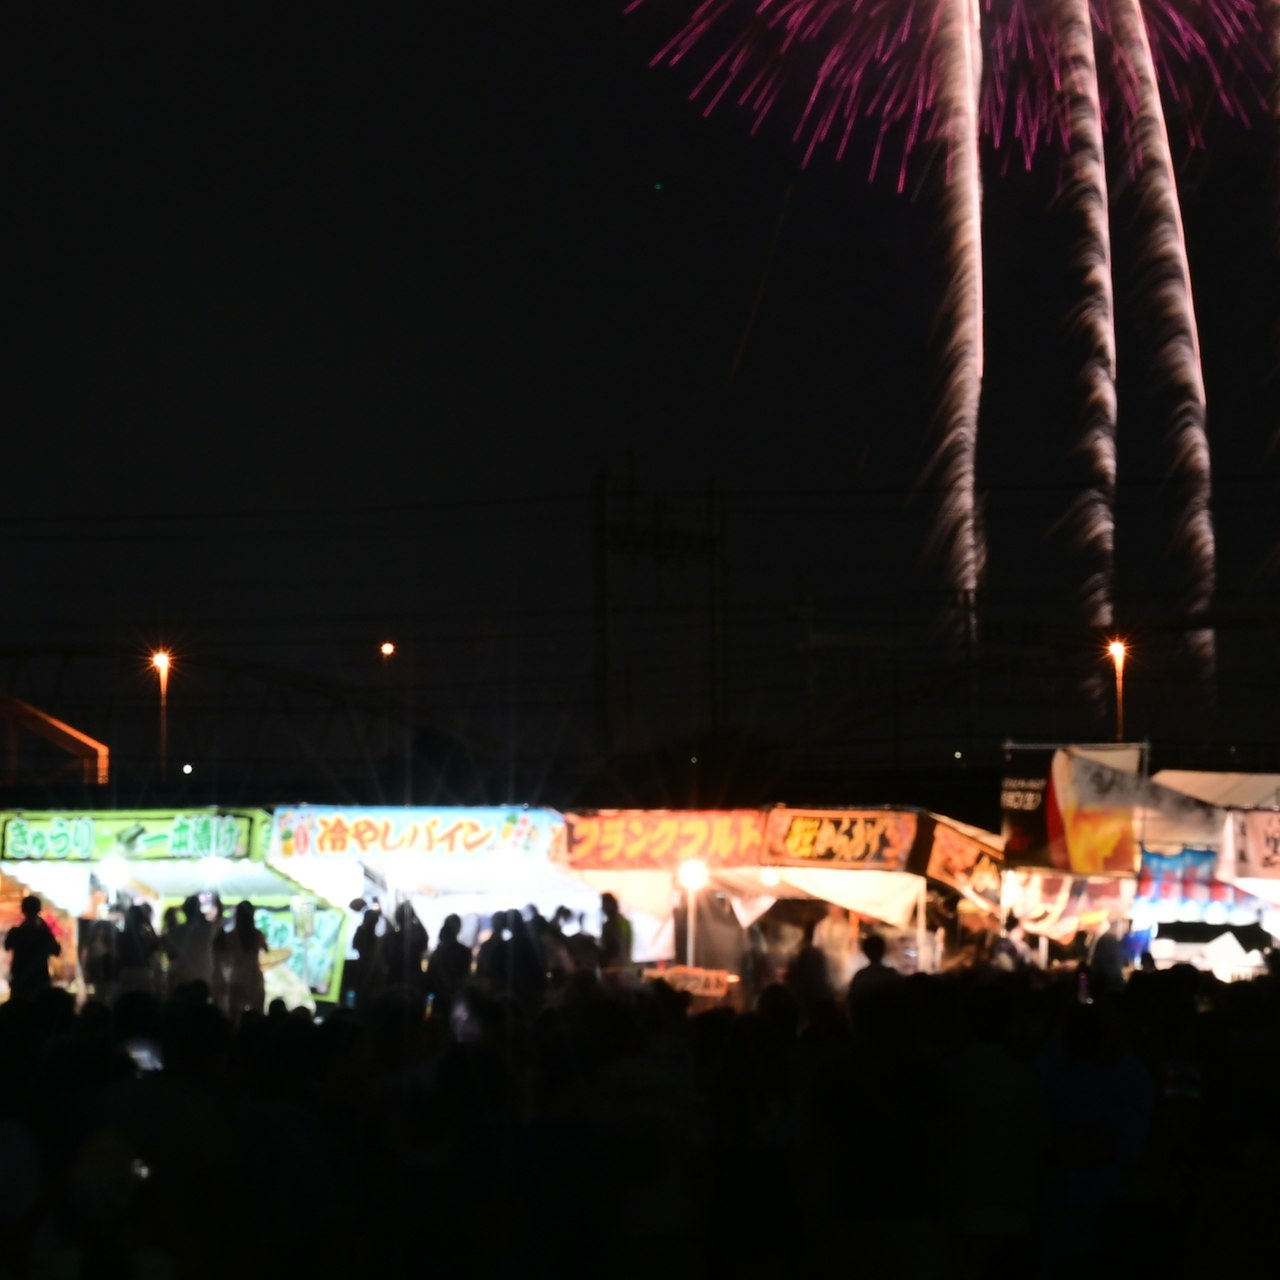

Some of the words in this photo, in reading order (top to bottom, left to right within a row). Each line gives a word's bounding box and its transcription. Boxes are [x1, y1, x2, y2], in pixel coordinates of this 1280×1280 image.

[9, 816, 94, 858] きゅうり
[141, 815, 239, 857] 一本漬け
[317, 817, 494, 853] 冷やしパイン
[571, 816, 763, 860] フランクフルト
